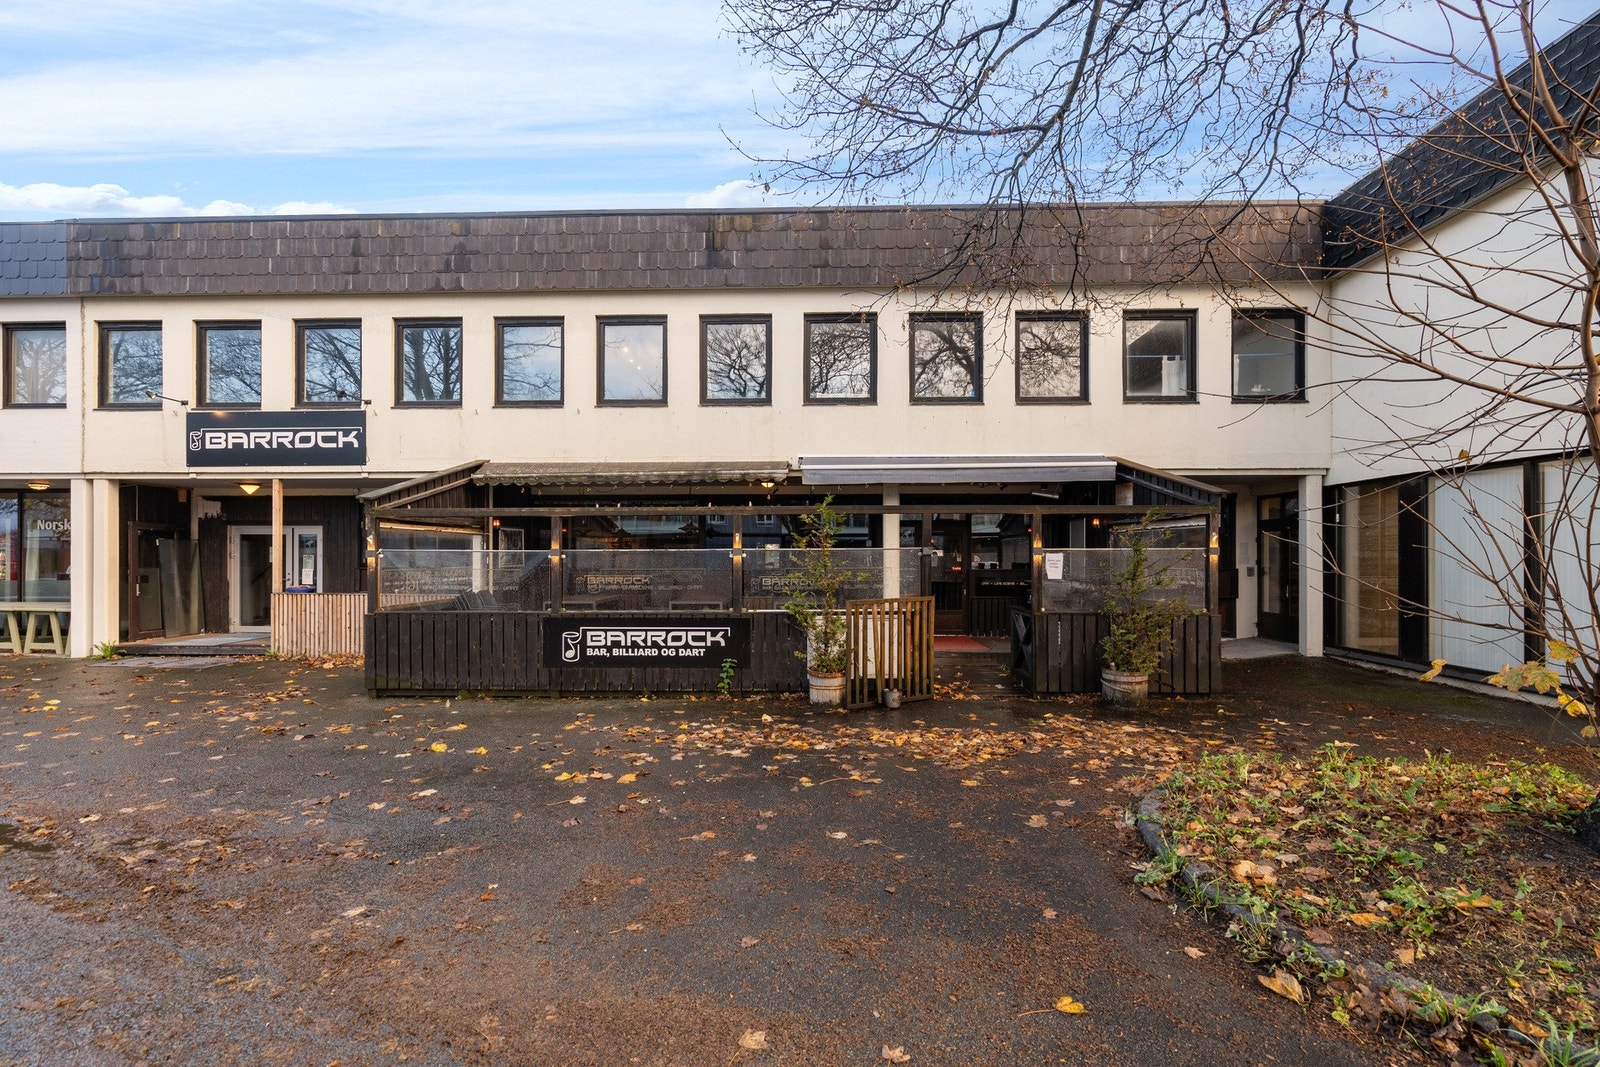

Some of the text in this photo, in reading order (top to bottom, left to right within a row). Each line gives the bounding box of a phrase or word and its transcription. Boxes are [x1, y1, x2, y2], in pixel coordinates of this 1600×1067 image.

[205, 430, 358, 449] BARROCK
[36, 519, 71, 531] Norsk
[586, 631, 726, 647] BARROCK
[586, 648, 706, 657] BAR, BILLIARD OG DART
